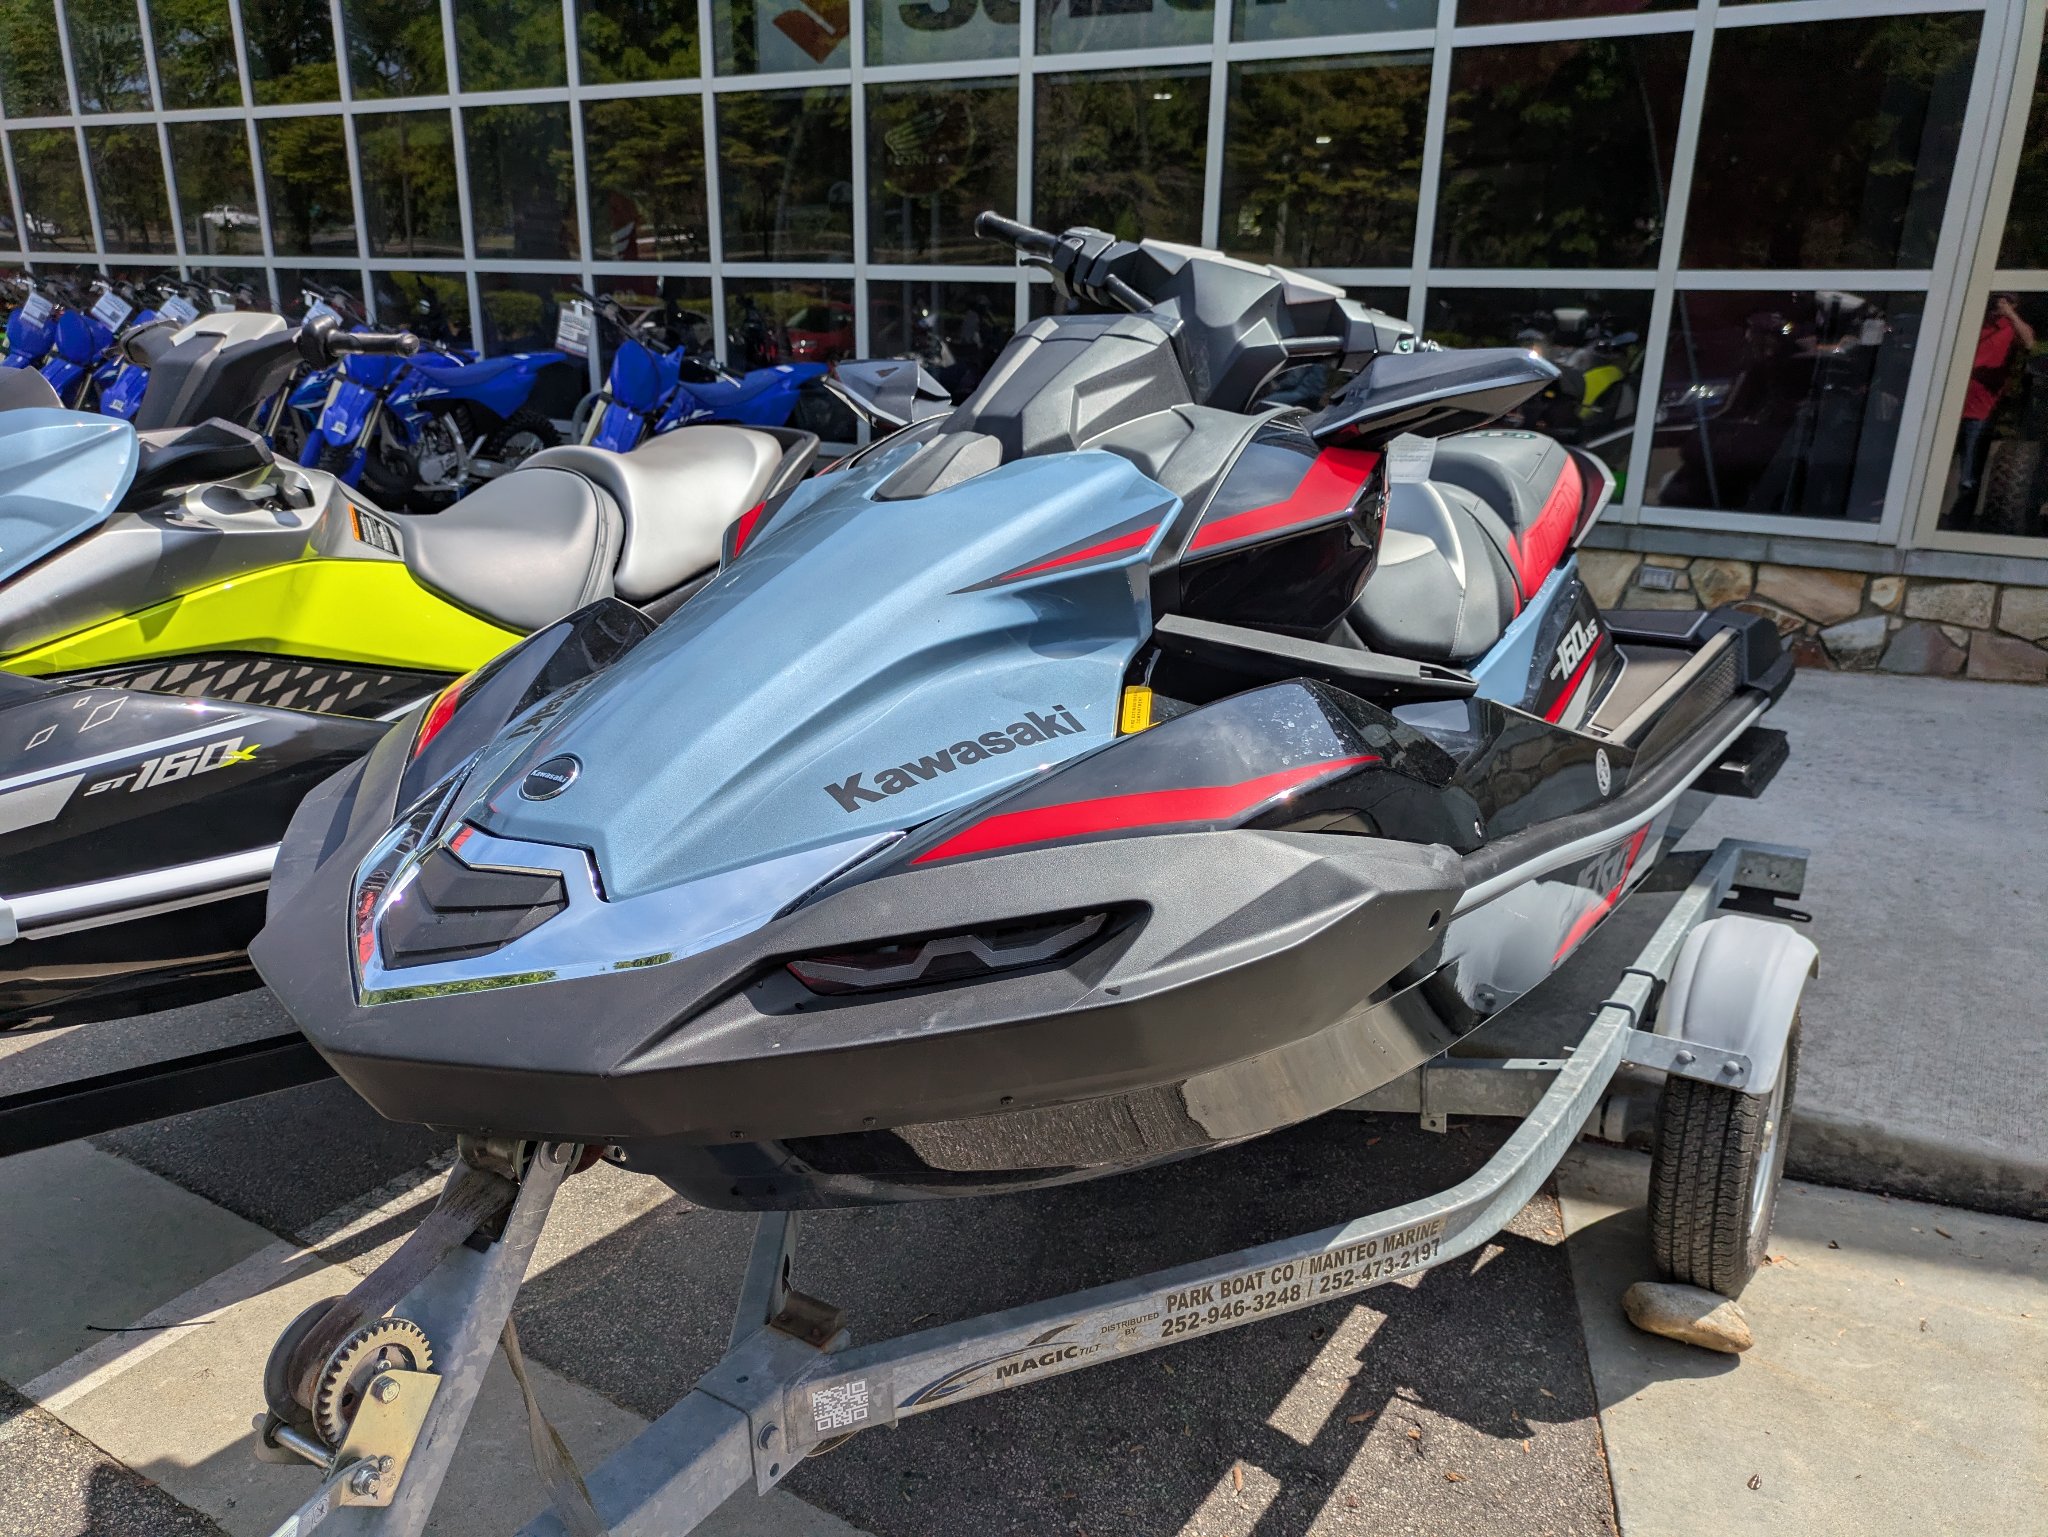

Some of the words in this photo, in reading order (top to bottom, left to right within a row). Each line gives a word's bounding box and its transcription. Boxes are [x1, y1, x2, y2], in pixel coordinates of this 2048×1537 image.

[530, 769, 569, 783] Kawasaki
[823, 704, 1087, 814] Kawasaki
[1166, 1284, 1214, 1314] PARK
[1220, 1271, 1267, 1298] BOAT
[1271, 1264, 1294, 1285] CO
[1309, 1240, 1378, 1275] MANTEO
[1382, 1218, 1440, 1255] MARINE
[1161, 1284, 1301, 1338] 252-946-3248
[1319, 1238, 1441, 1294] 252-473-2197
[1100, 1311, 1160, 1335] DISTRIBUTED
[1124, 1326, 1138, 1337] BY
[996, 1345, 1079, 1380] MAGIC
[1078, 1342, 1102, 1356] TILT
